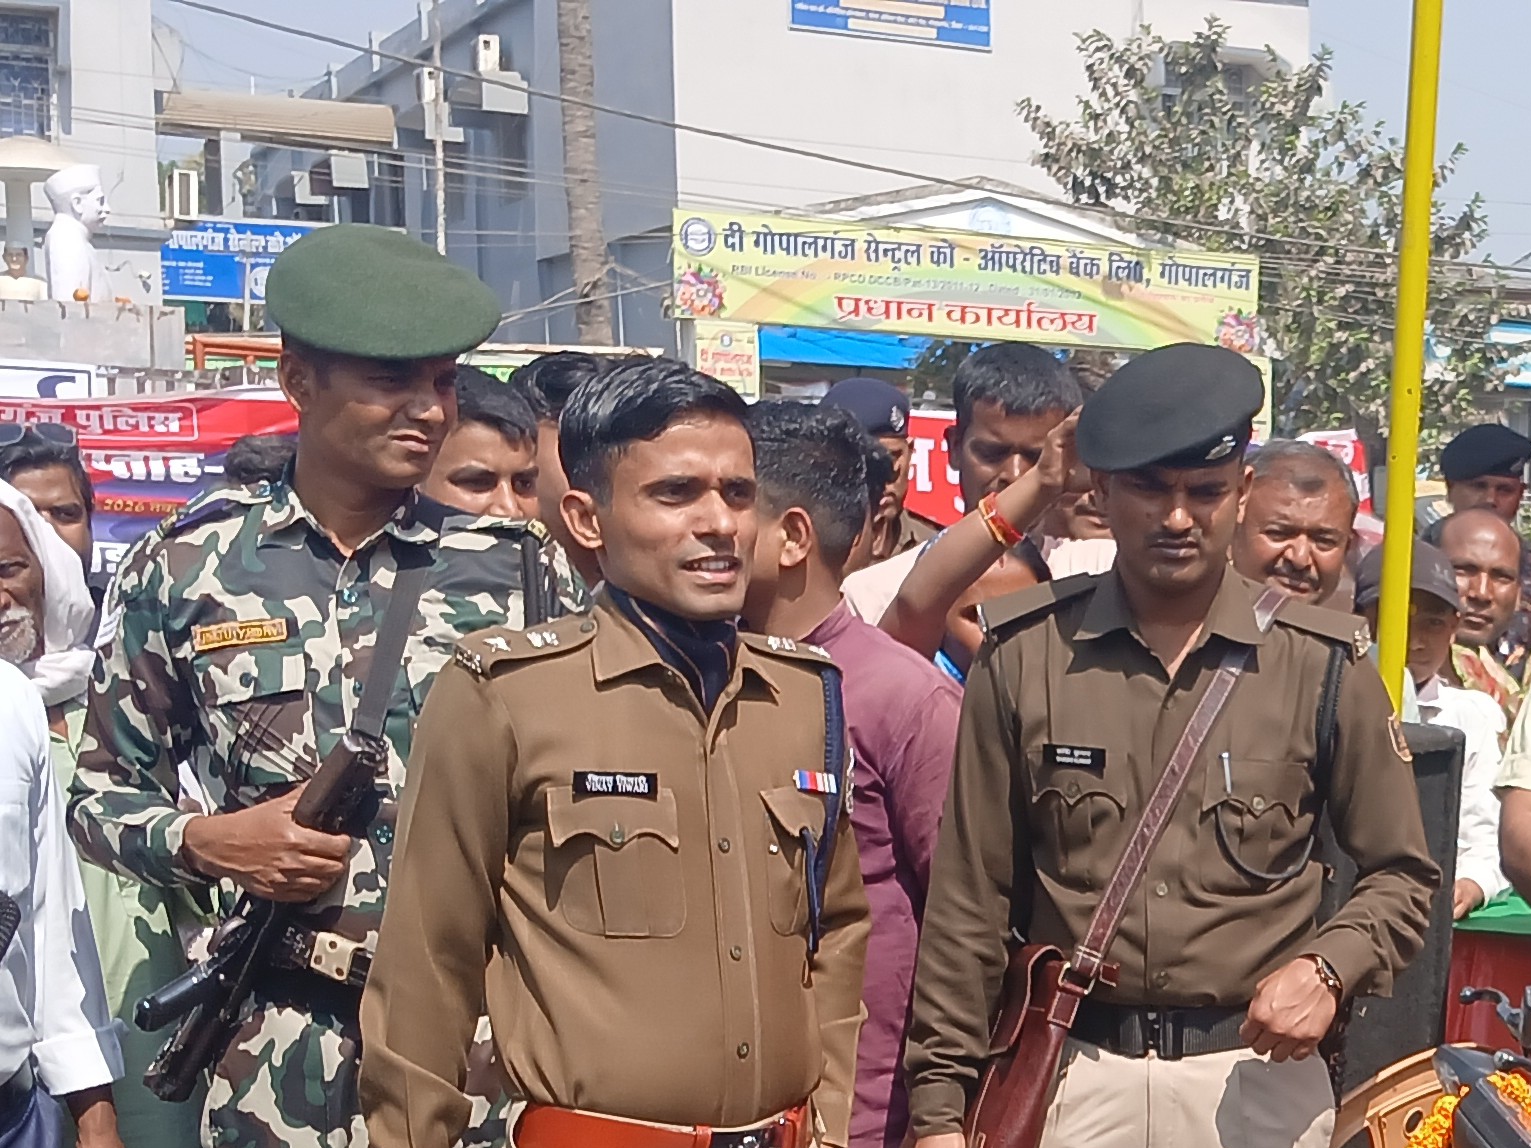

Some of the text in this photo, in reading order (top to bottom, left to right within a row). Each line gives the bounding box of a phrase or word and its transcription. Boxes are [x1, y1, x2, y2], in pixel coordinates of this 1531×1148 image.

[723, 222, 744, 252] दी
[753, 224, 857, 261] गोपालगंज
[929, 238, 956, 268] को
[1159, 255, 1252, 290] गोपालगंज
[834, 295, 1098, 334] प्रधान कार्यालय
[75, 407, 183, 434] पुलिस
[104, 499, 145, 512] 2026
